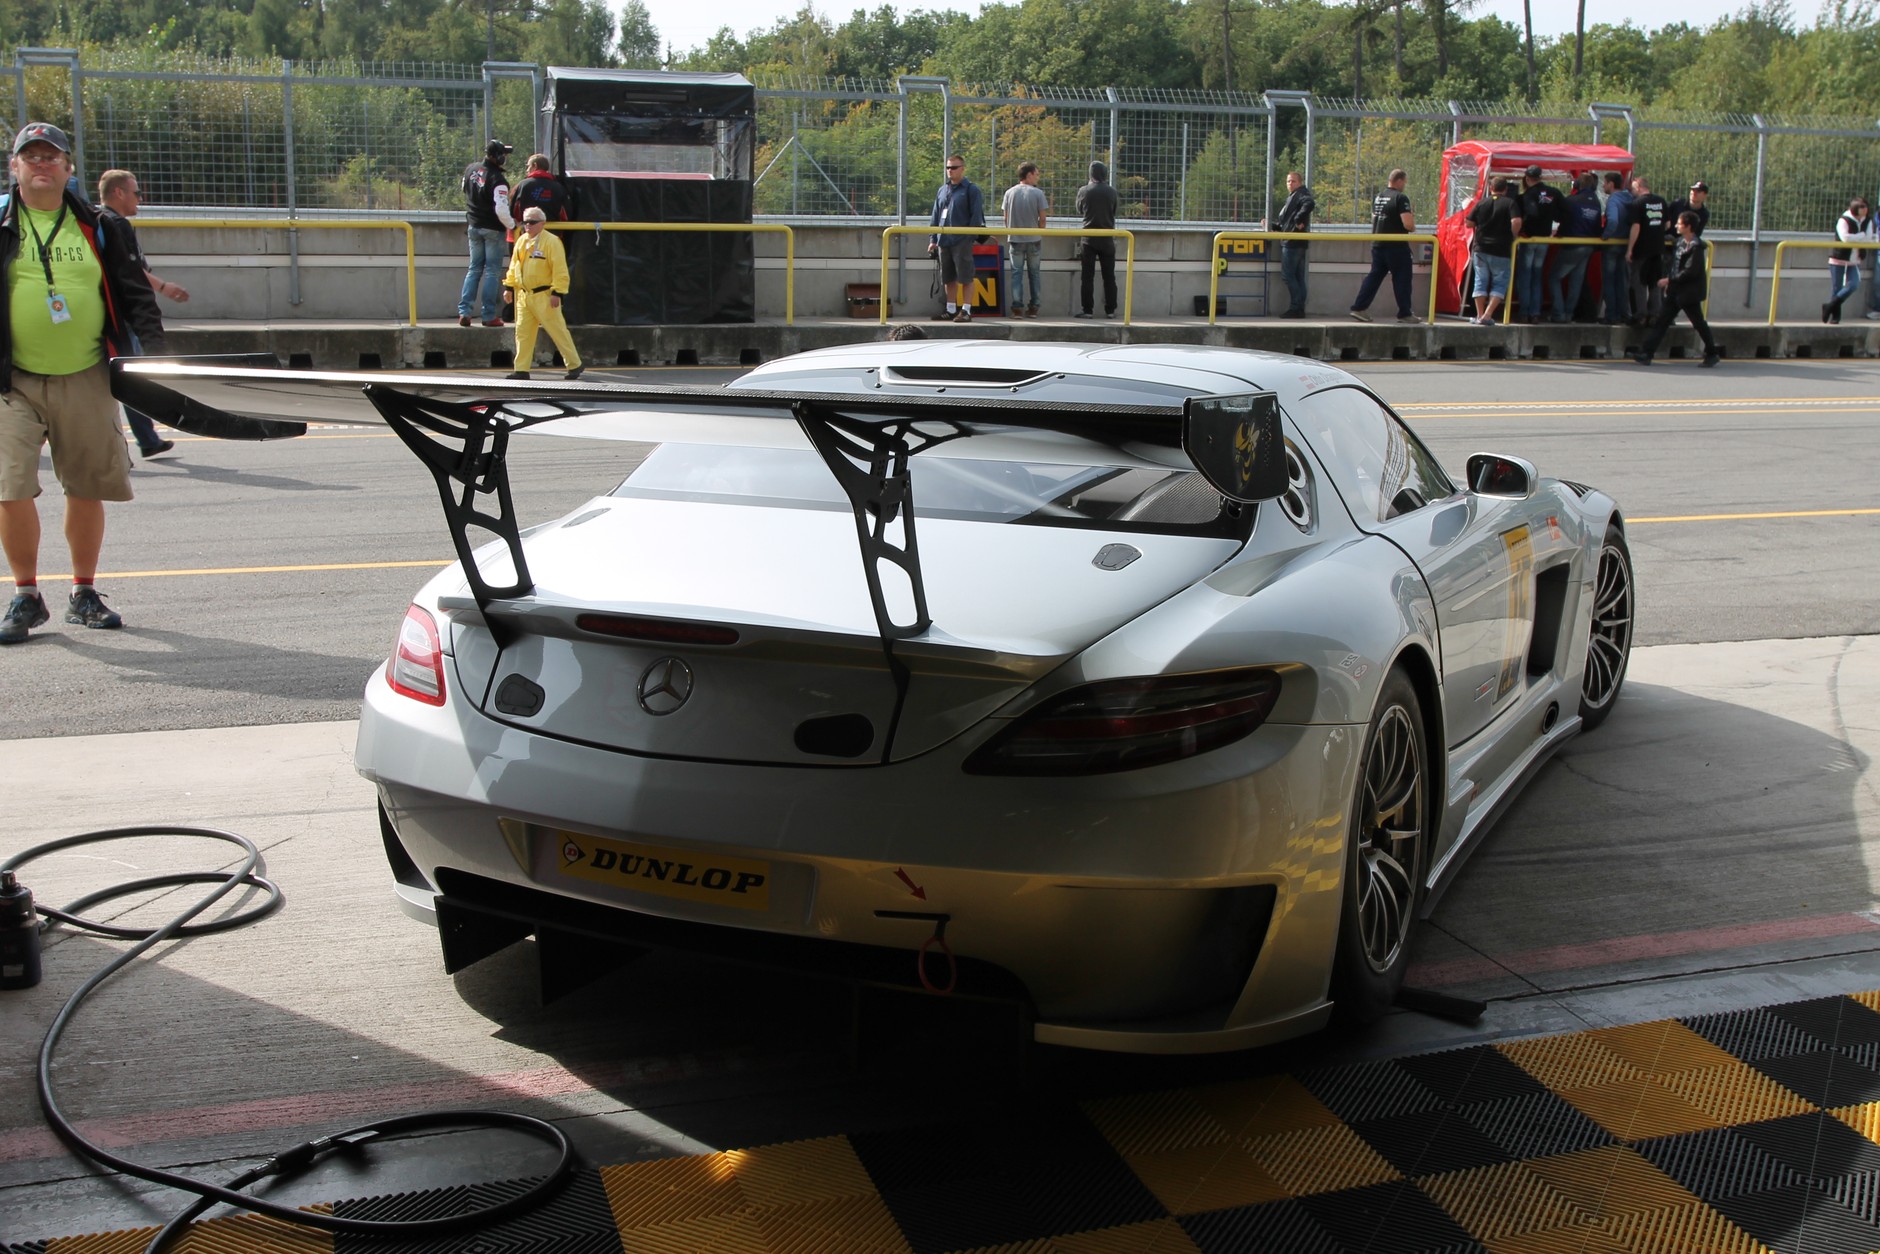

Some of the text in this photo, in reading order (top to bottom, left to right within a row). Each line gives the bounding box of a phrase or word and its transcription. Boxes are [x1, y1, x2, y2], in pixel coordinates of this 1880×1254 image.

[31, 246, 84, 262] IAR-CS
[1219, 239, 1265, 254] TOM
[590, 847, 765, 894] DUNLOP
